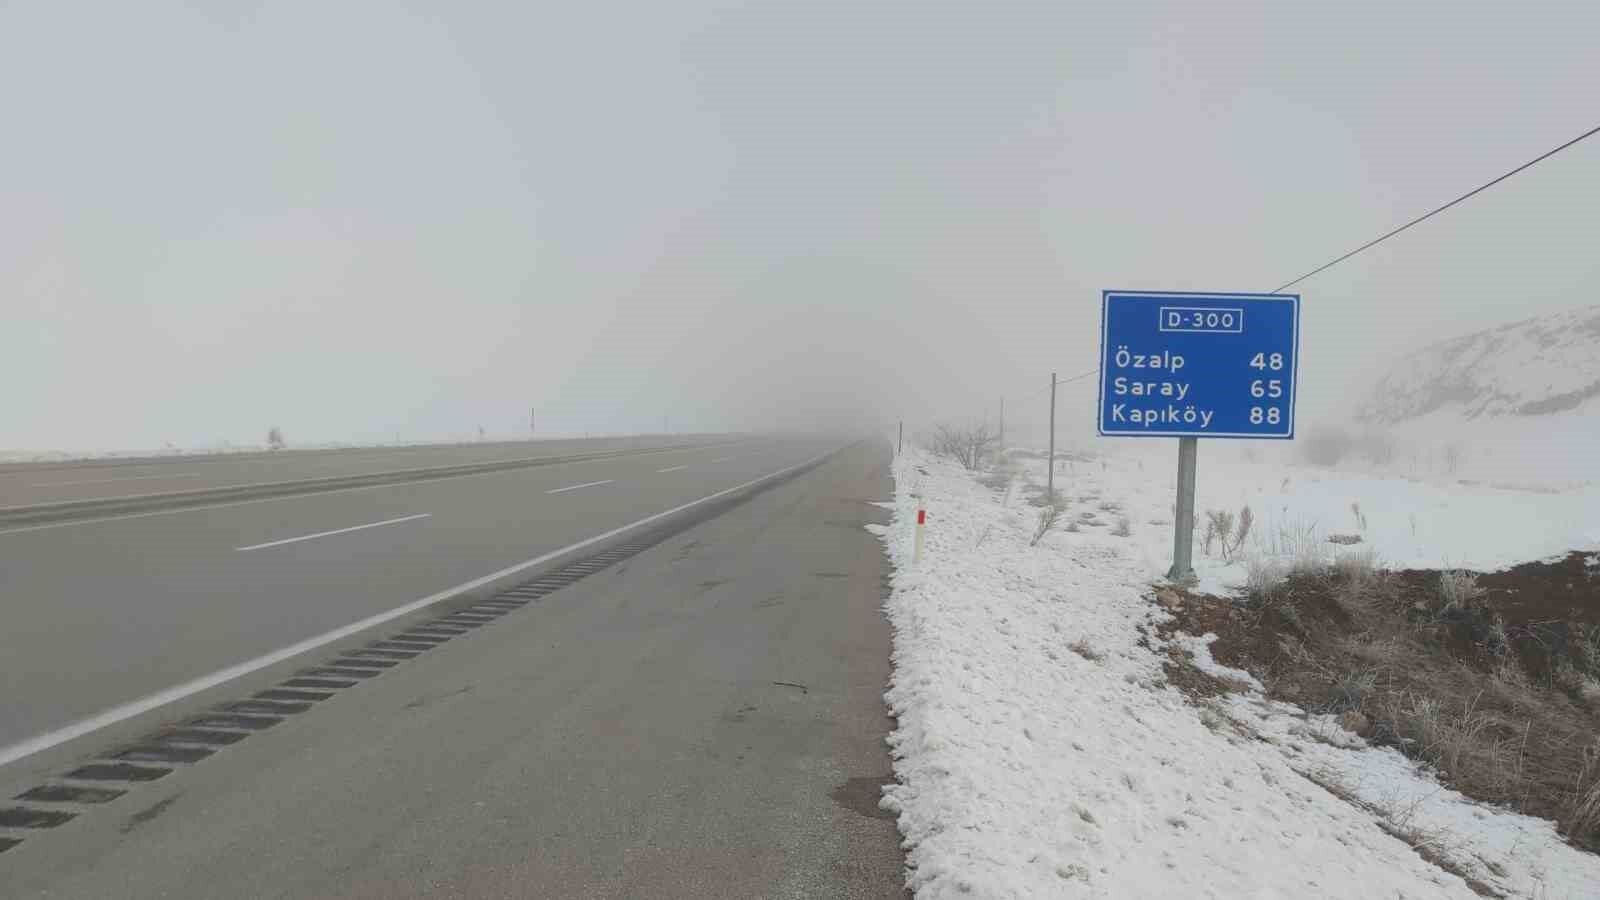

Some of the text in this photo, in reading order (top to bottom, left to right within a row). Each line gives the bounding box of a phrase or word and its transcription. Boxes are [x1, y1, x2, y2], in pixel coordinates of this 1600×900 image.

[1168, 312, 1234, 328] D-300
[1115, 345, 1284, 373] Özalp 48
[1114, 377, 1283, 401] Saray 65
[1112, 404, 1281, 428] Kapıköy 88
